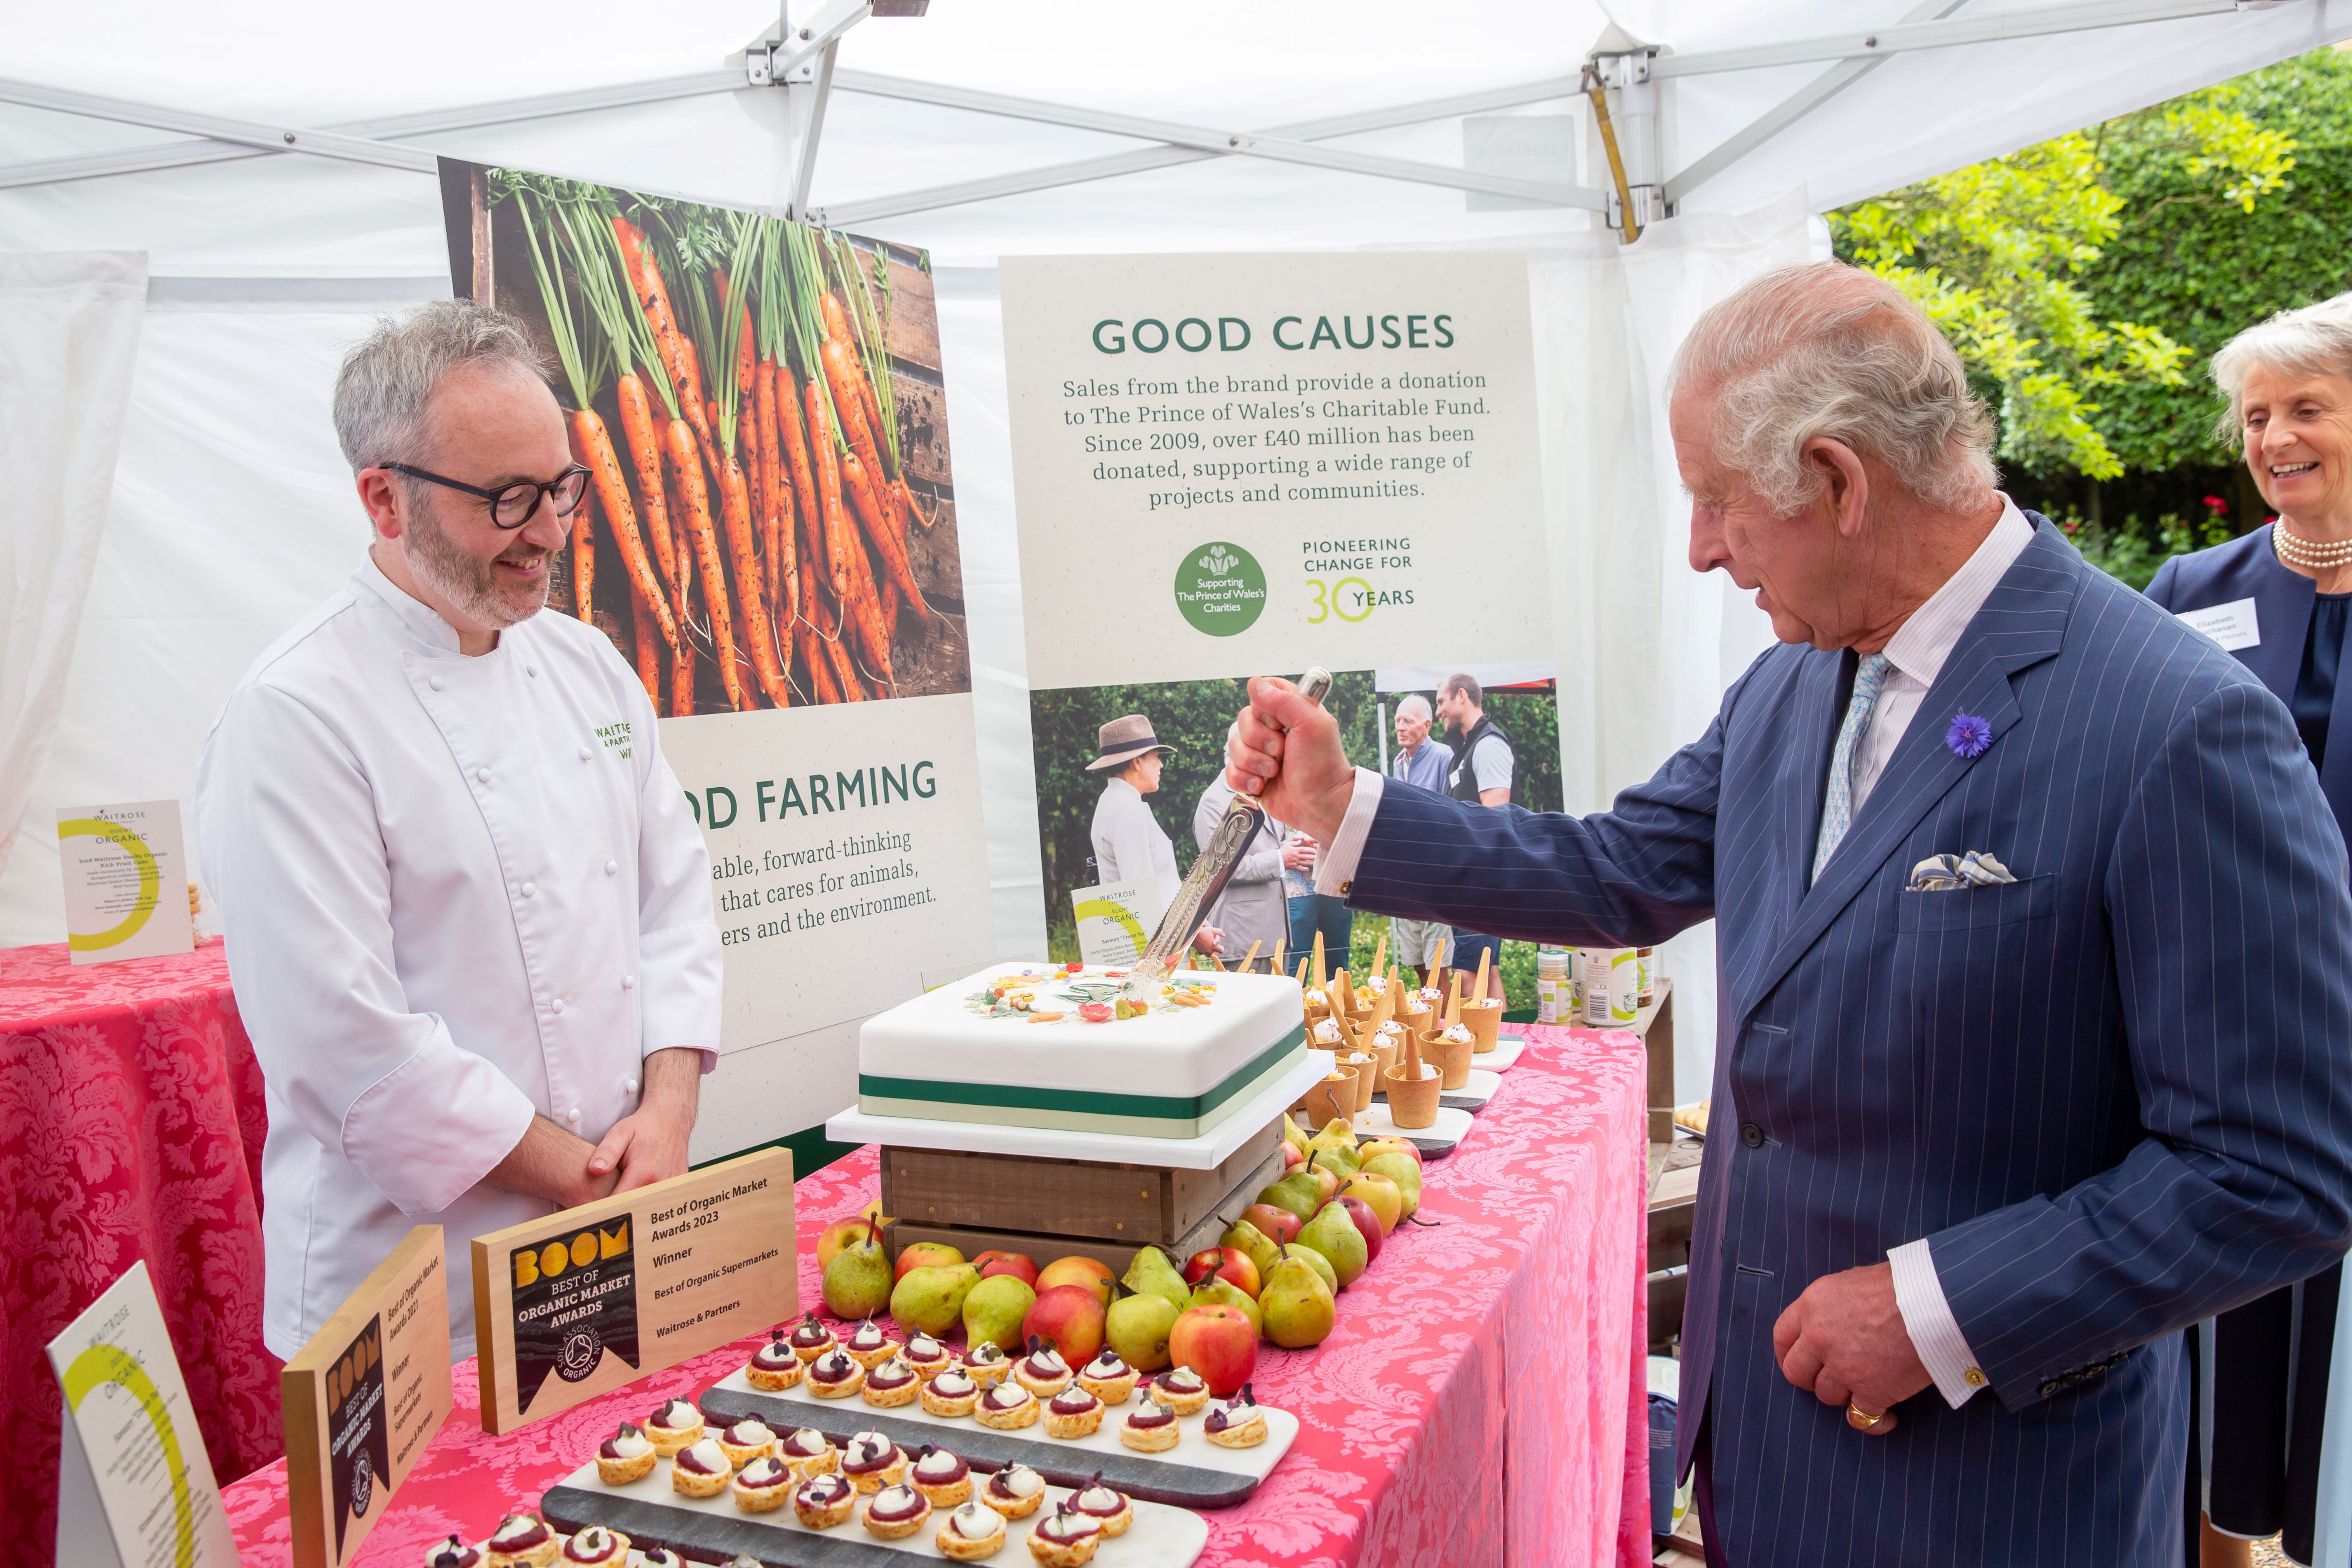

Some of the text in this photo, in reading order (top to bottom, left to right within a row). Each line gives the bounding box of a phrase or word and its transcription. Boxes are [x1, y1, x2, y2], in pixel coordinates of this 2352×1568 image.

[1092, 315, 1454, 354] GOOD CAUSES
[1064, 371, 1486, 397] Sales from the brand provide a donation
[1064, 397, 1490, 424] to The Prince of Wales's Charitable Fund.
[1085, 425, 1473, 452] Since 2009, over £40 million has been
[1093, 451, 1472, 480] donated, supporting a wide range of
[1149, 483, 1425, 510] projects and communities.
[1303, 538, 1410, 553] PIONEERING
[1304, 556, 1411, 571] CHANGE FOR
[1177, 588, 1264, 601] The Prince of Wales's
[1197, 578, 1243, 590] Supporting
[1203, 603, 1240, 612] Charities
[1306, 577, 1414, 624] 30 YEARS
[594, 723, 631, 737] WAITRE
[609, 735, 631, 746] PARTN
[756, 761, 935, 822] FARMING
[94, 812, 145, 821] WAITROSE
[96, 833, 147, 844] ORGANIC
[763, 832, 911, 871] forward-thinking
[720, 861, 918, 912] that cares for animals,
[1099, 890, 1136, 901] WAITROSE
[757, 913, 792, 938] and
[797, 909, 824, 930] the
[831, 887, 936, 922] environment.
[1103, 912, 1139, 925] ORGANIC
[651, 1178, 767, 1224] Best of Organic Market
[652, 1211, 718, 1242] Awards 2023
[515, 1220, 629, 1288] BOOM
[653, 1247, 692, 1268] Winner
[388, 1256, 438, 1321] Best of Organic Market
[551, 1269, 598, 1295] BEST OF
[655, 1249, 778, 1299] Best of Organic Supermarkets
[519, 1274, 630, 1322] ORGANIC MARKET
[390, 1299, 418, 1342] Awards 2021
[550, 1300, 602, 1328] AWARDS
[656, 1300, 740, 1337] Waitrose & Partners
[557, 1324, 600, 1368] SOIL ASSOCIATION
[328, 1321, 380, 1416] BOOM
[392, 1354, 409, 1382] Winner
[563, 1358, 596, 1378] ORGANIC
[346, 1382, 367, 1418] BEST OF
[394, 1373, 422, 1416] Best of Organic
[333, 1383, 382, 1455] ORGANIC MARKET
[395, 1392, 421, 1433] Supermarkets
[348, 1418, 371, 1457] AWARDS
[397, 1410, 433, 1465] Waitrose & Partners
